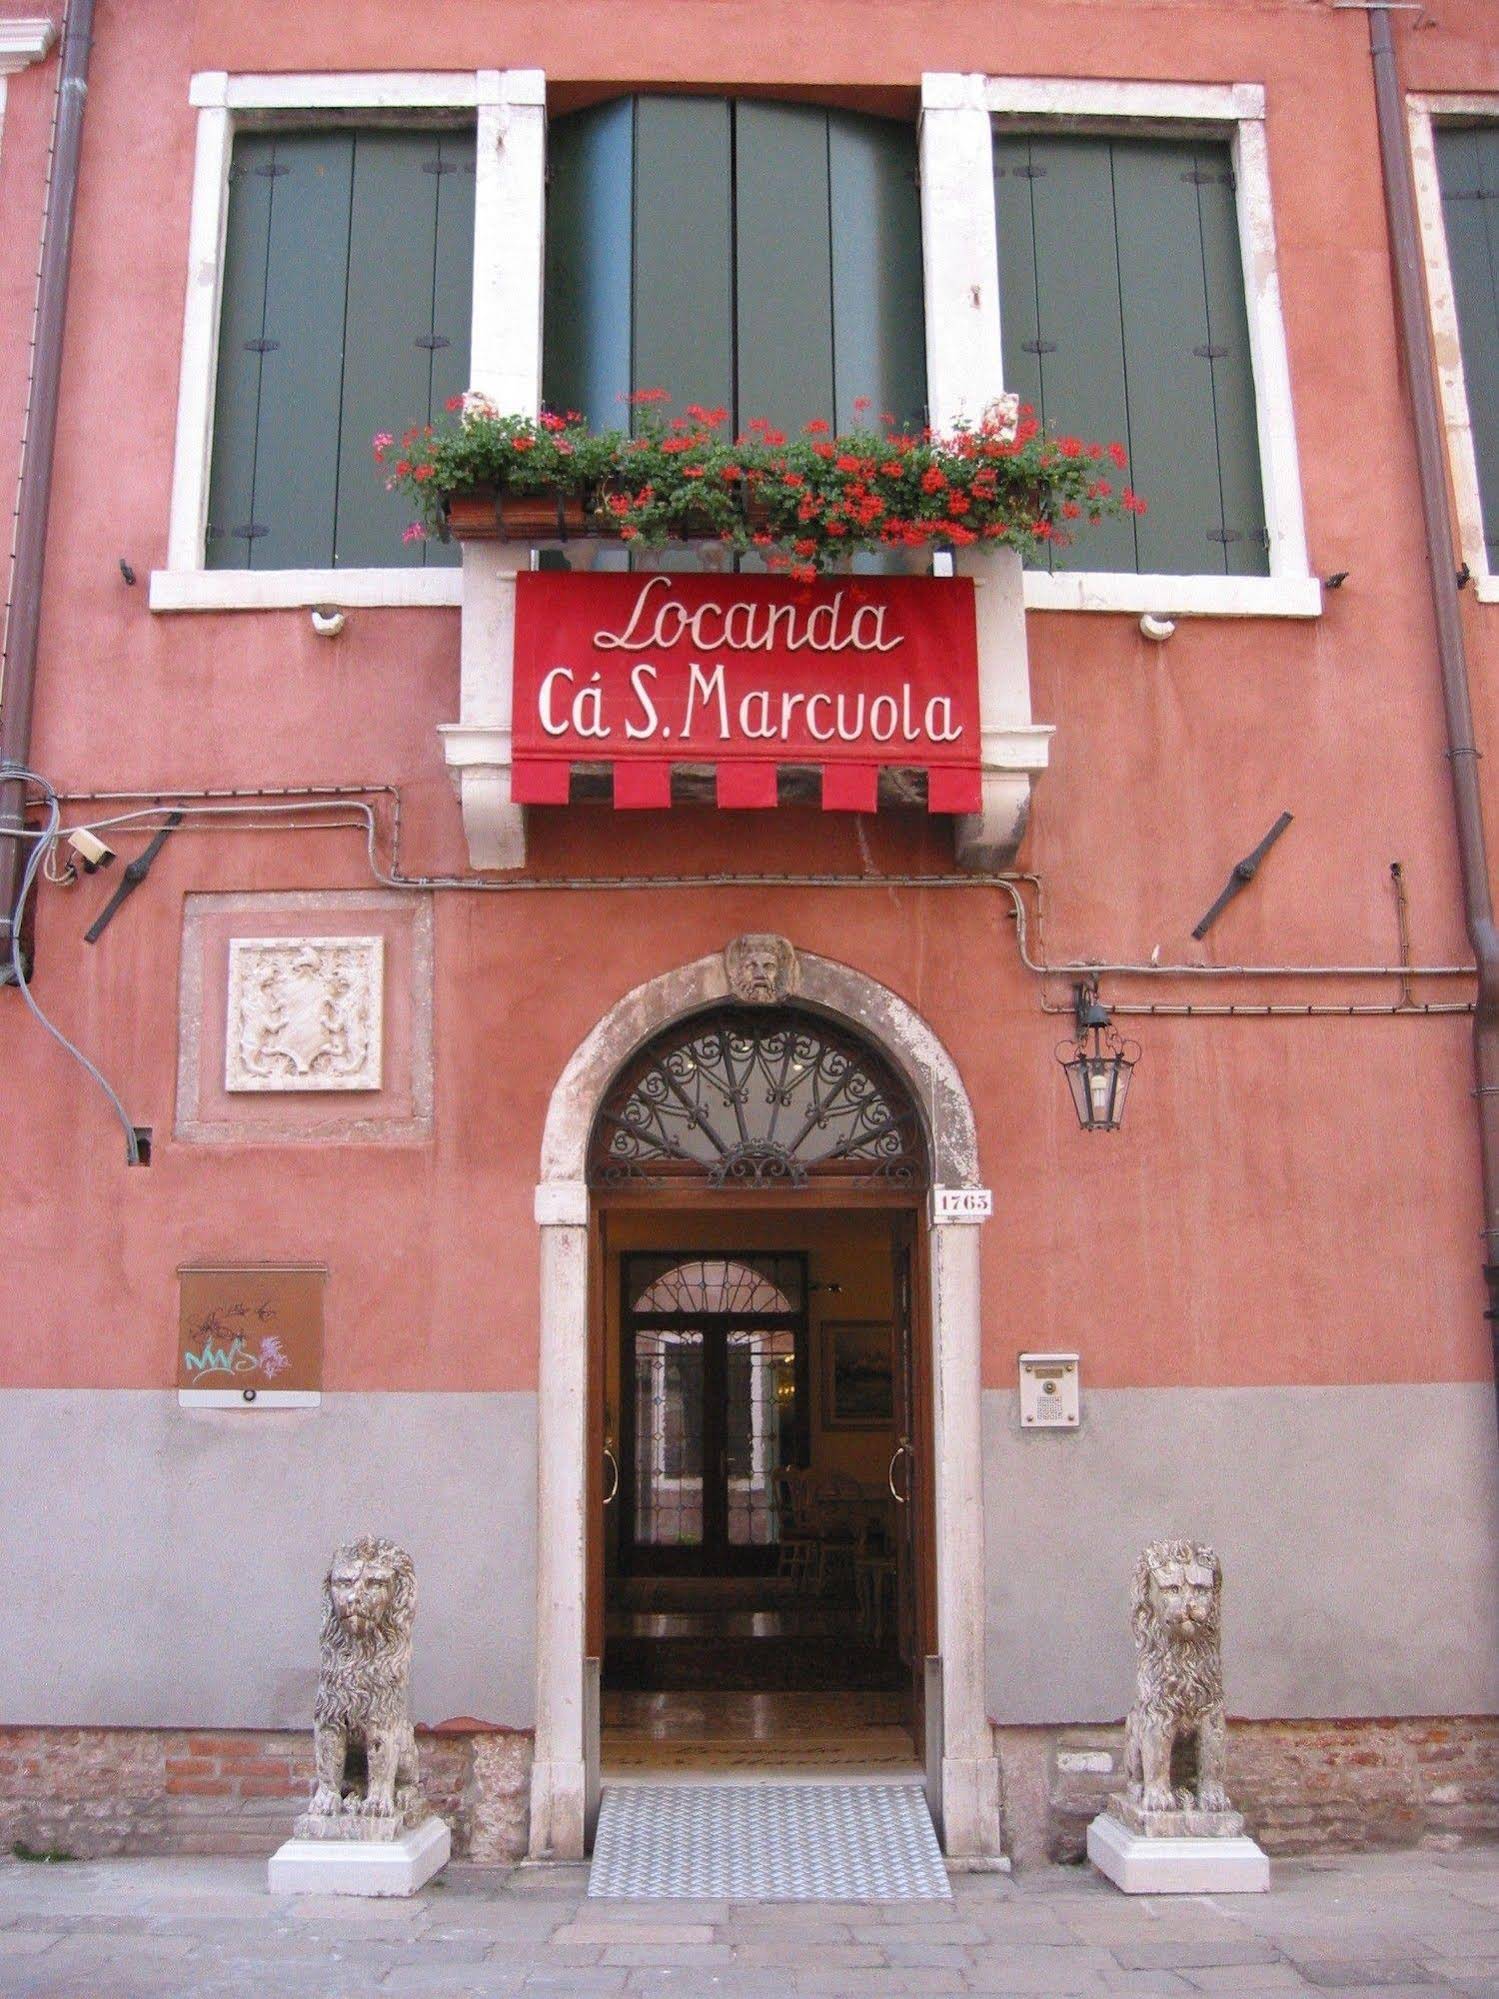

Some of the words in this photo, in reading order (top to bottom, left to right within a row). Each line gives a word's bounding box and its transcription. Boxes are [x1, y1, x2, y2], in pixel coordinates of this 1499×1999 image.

[594, 576, 904, 653] Locanda
[538, 668, 610, 738] Cá
[680, 663, 963, 743] Marcuola
